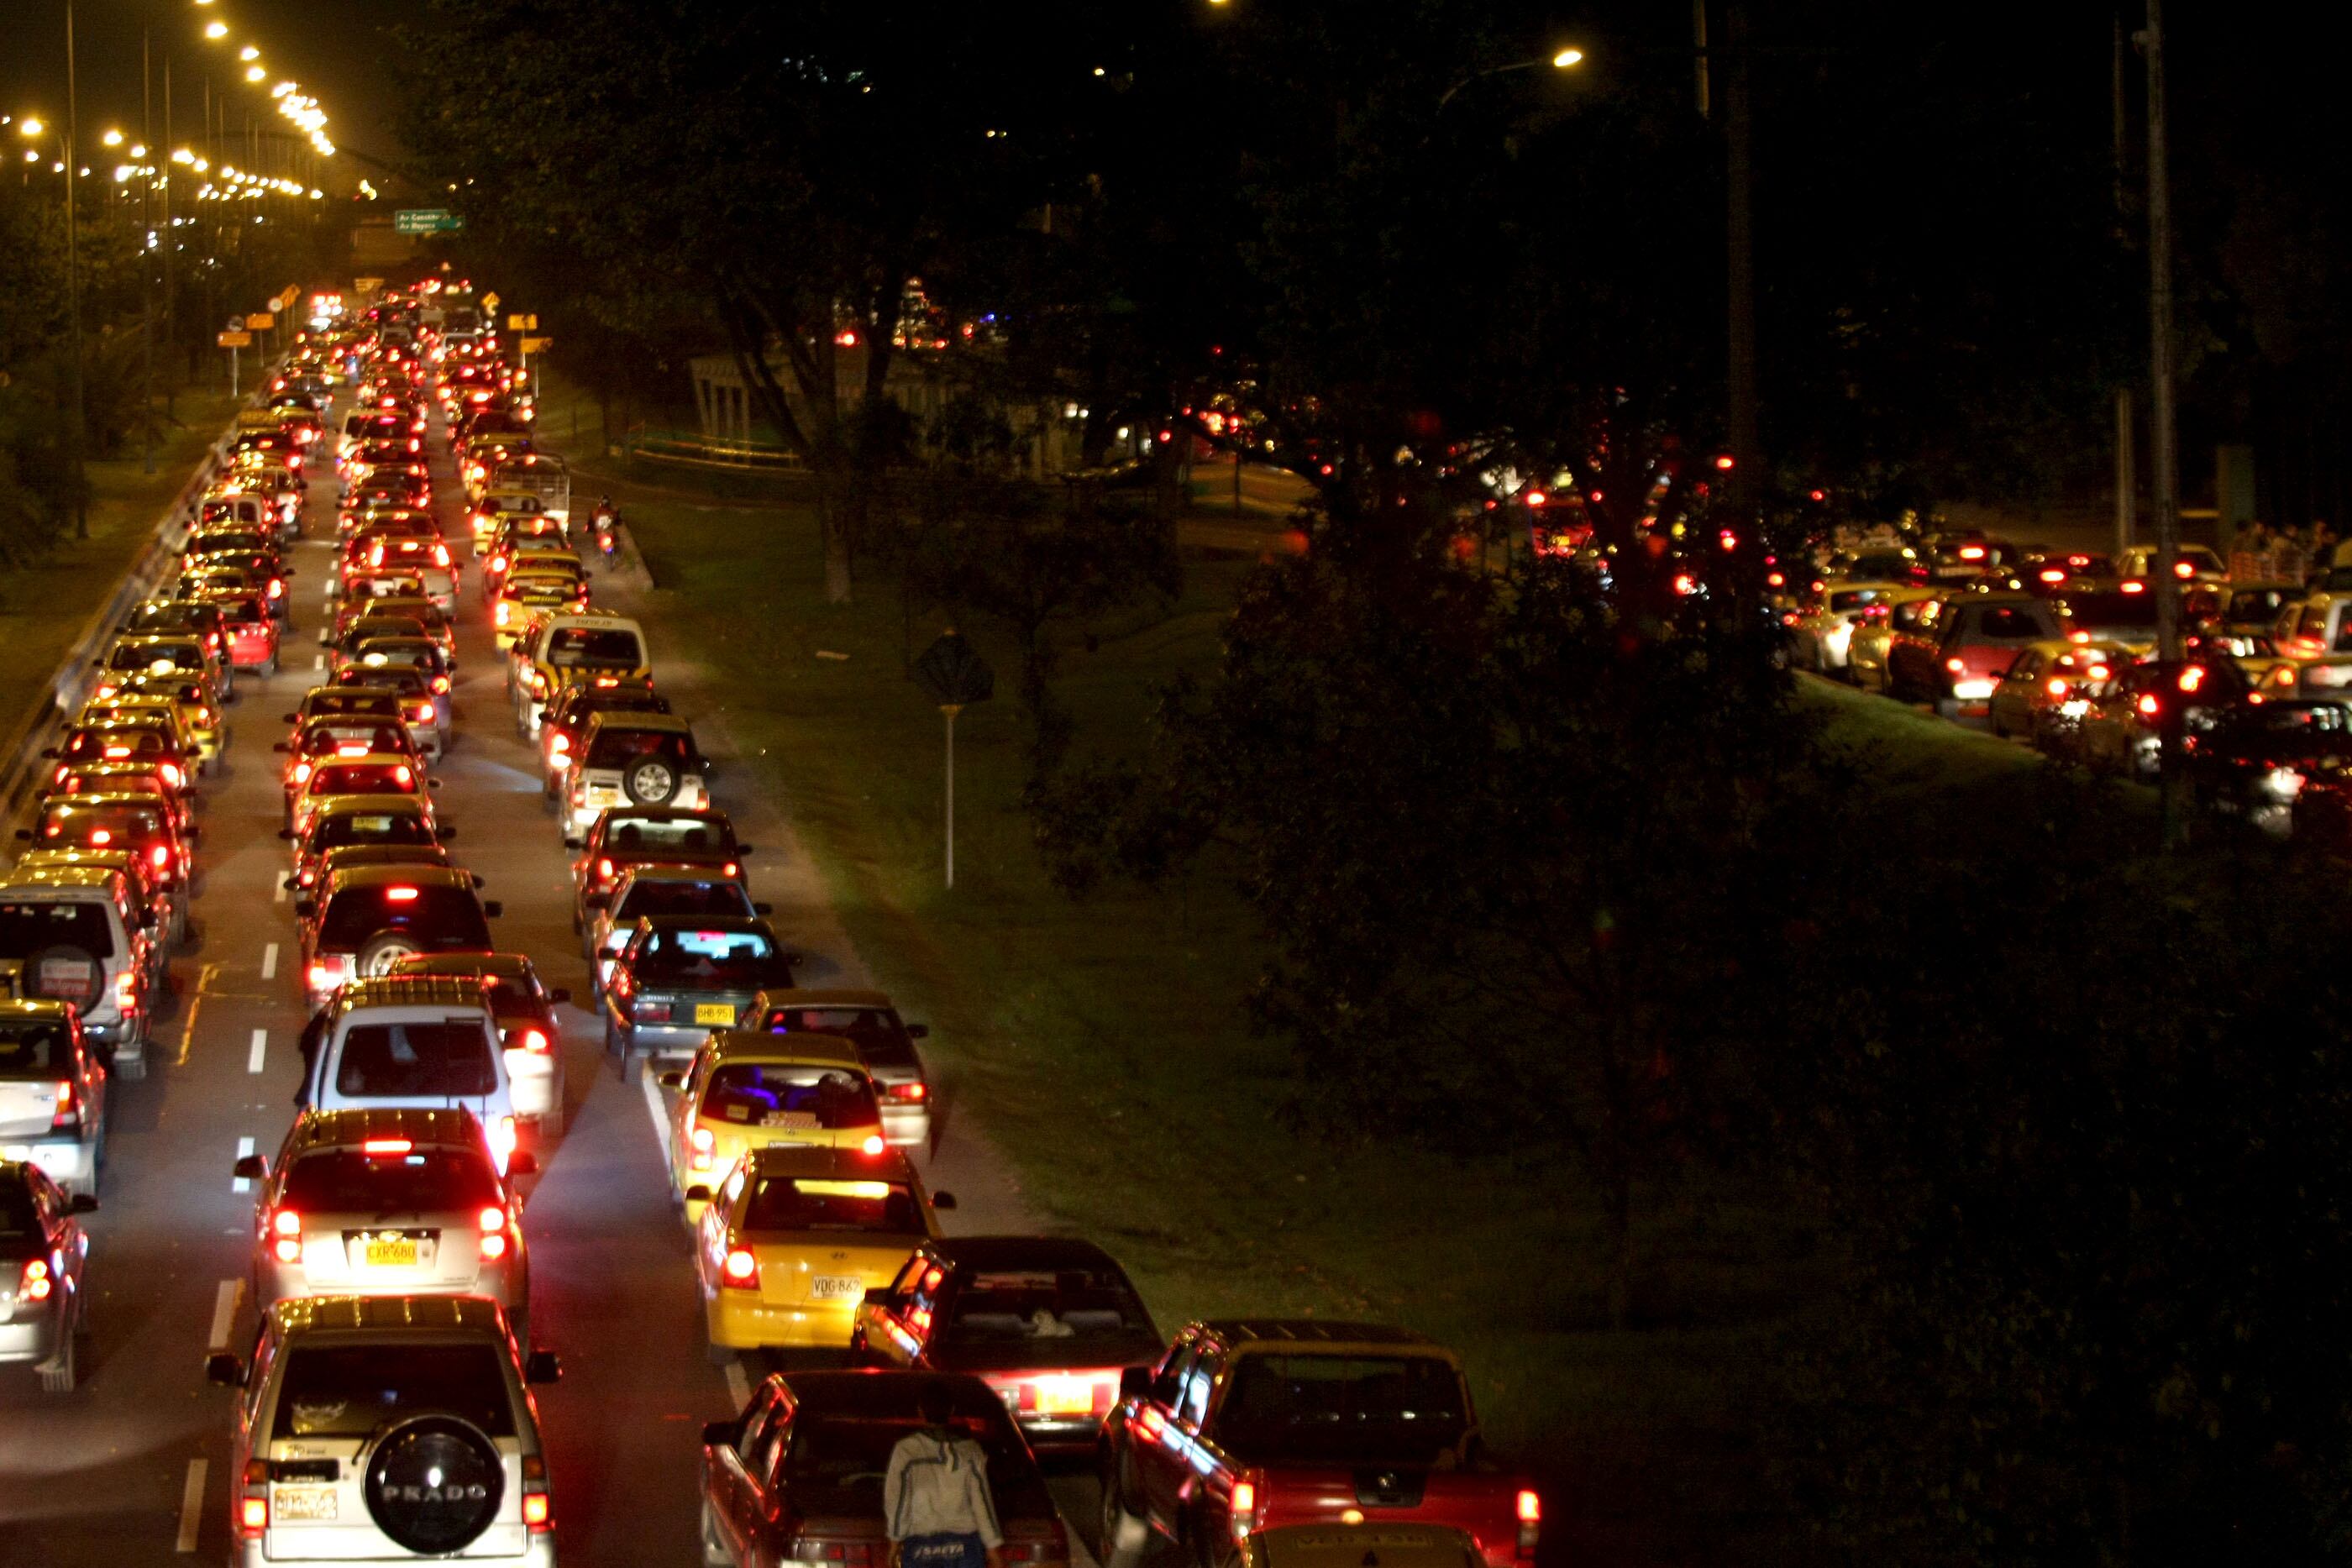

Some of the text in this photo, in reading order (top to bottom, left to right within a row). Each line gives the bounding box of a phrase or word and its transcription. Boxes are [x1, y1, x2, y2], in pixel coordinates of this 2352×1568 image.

[368, 1245, 416, 1258] CXR 680
[383, 1484, 486, 1502] PRADO
